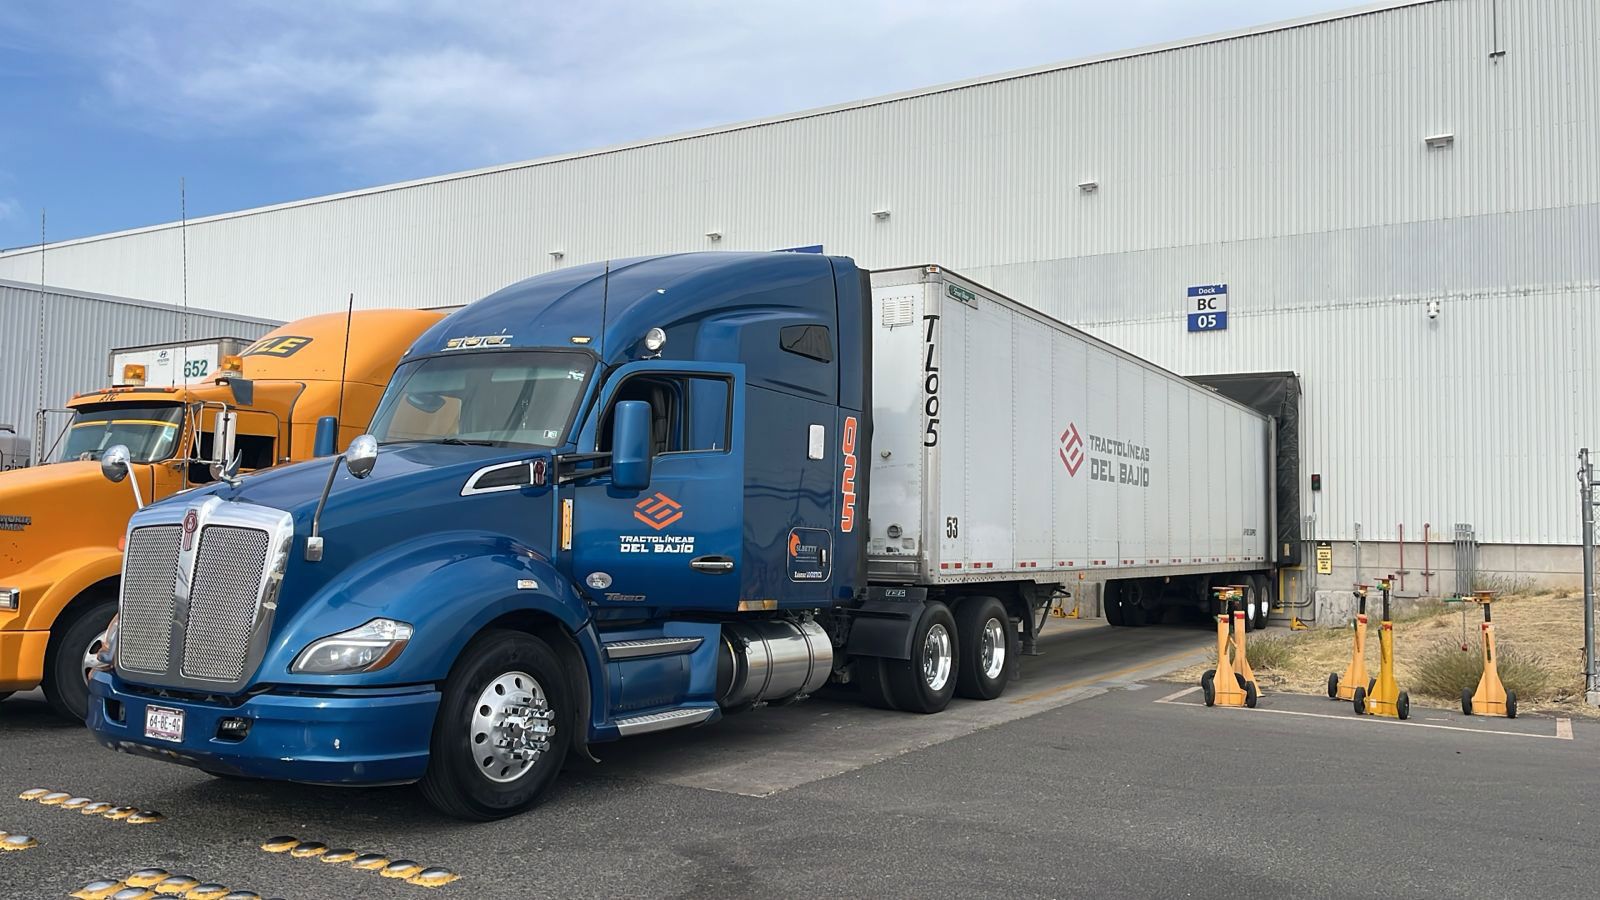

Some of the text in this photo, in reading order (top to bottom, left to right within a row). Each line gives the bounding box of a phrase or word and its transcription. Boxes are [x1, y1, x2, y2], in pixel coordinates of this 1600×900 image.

[1198, 287, 1216, 295] Dock
[1197, 298, 1217, 311] BC
[1197, 314, 1217, 328] 05
[183, 359, 209, 378] 652
[923, 314, 940, 447] TL005
[1088, 434, 1150, 462] TRACTOLÍNEAS
[1090, 457, 1150, 488] DEL BAJÍO
[946, 516, 958, 539] 53
[619, 534, 695, 543] TRACTOLÍNEAS
[620, 542, 694, 553] DEL BAJÍO
